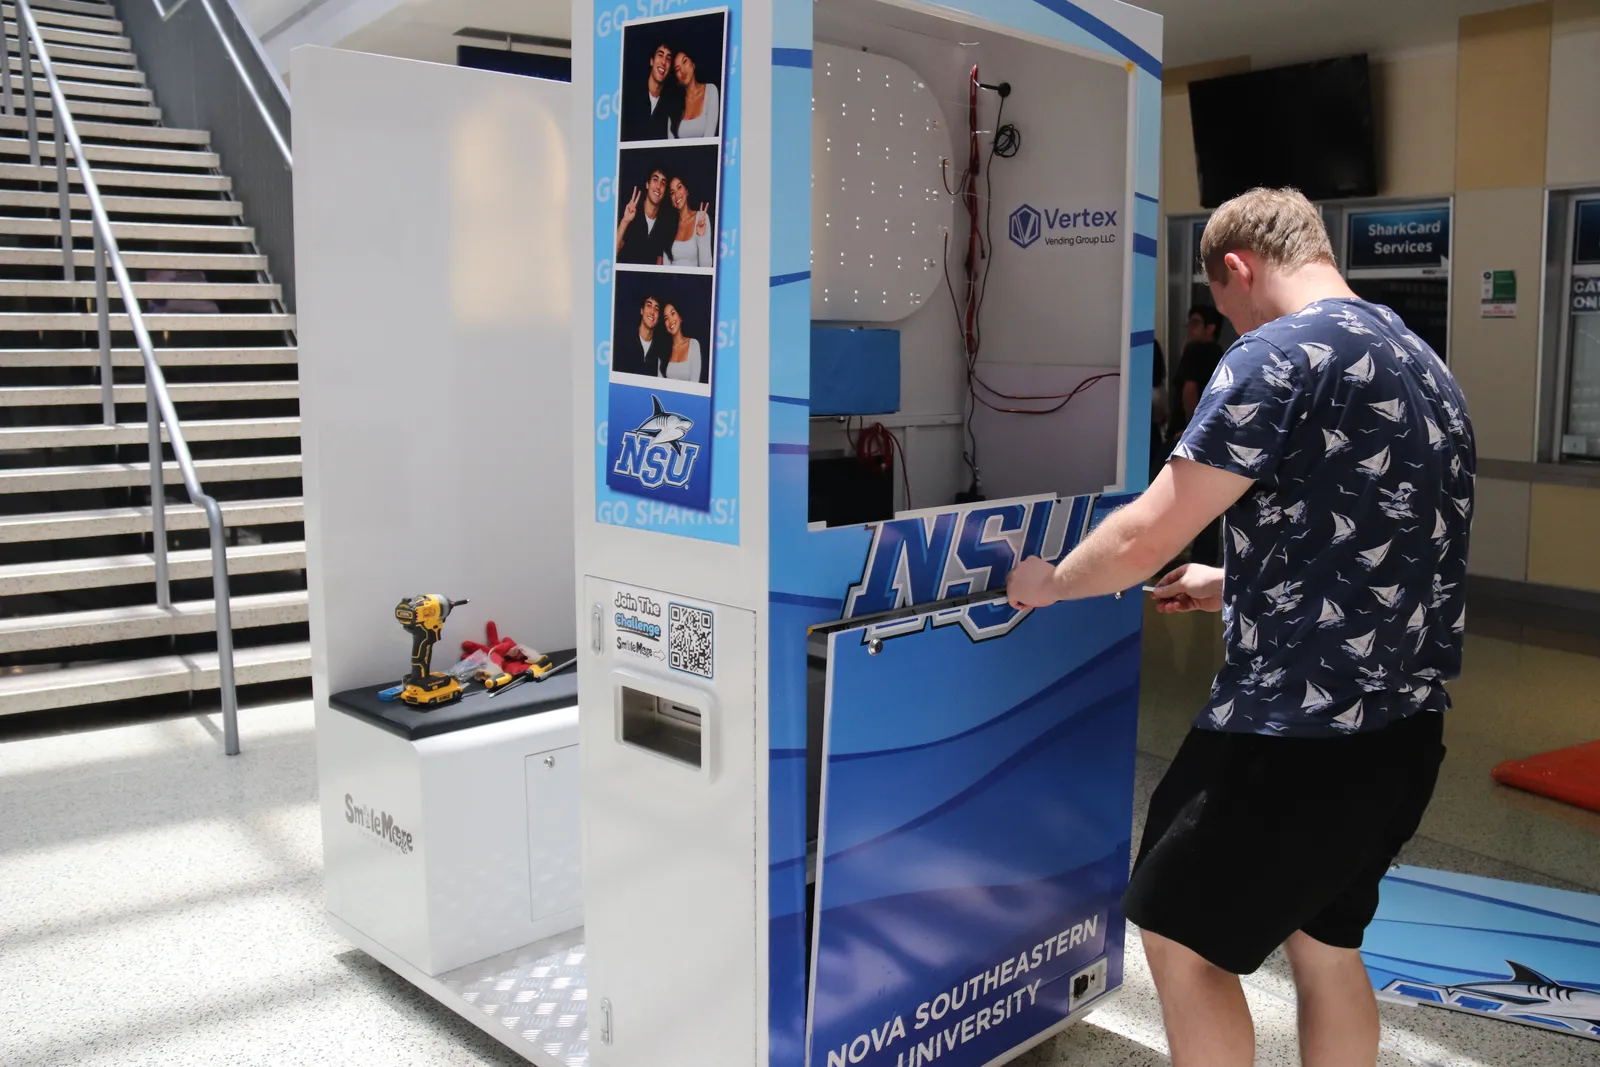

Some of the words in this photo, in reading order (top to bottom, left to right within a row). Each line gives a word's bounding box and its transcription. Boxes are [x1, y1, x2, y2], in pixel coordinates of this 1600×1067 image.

[1044, 208, 1117, 229] Vertex
[1368, 220, 1441, 237] SharkCard
[1045, 236, 1075, 246] Vending
[1075, 235, 1099, 246] Group
[1100, 234, 1116, 243] LLC
[1374, 240, 1433, 254] Services
[612, 430, 701, 489] NSU
[598, 500, 629, 525] GO
[614, 591, 638, 611] Join
[637, 596, 661, 617] The
[615, 612, 661, 638] Challenge
[826, 1015, 906, 1067] NOVA
[914, 914, 1098, 1030] SOUTHEASTERN
[897, 978, 1042, 1067] UNIVERSITY
